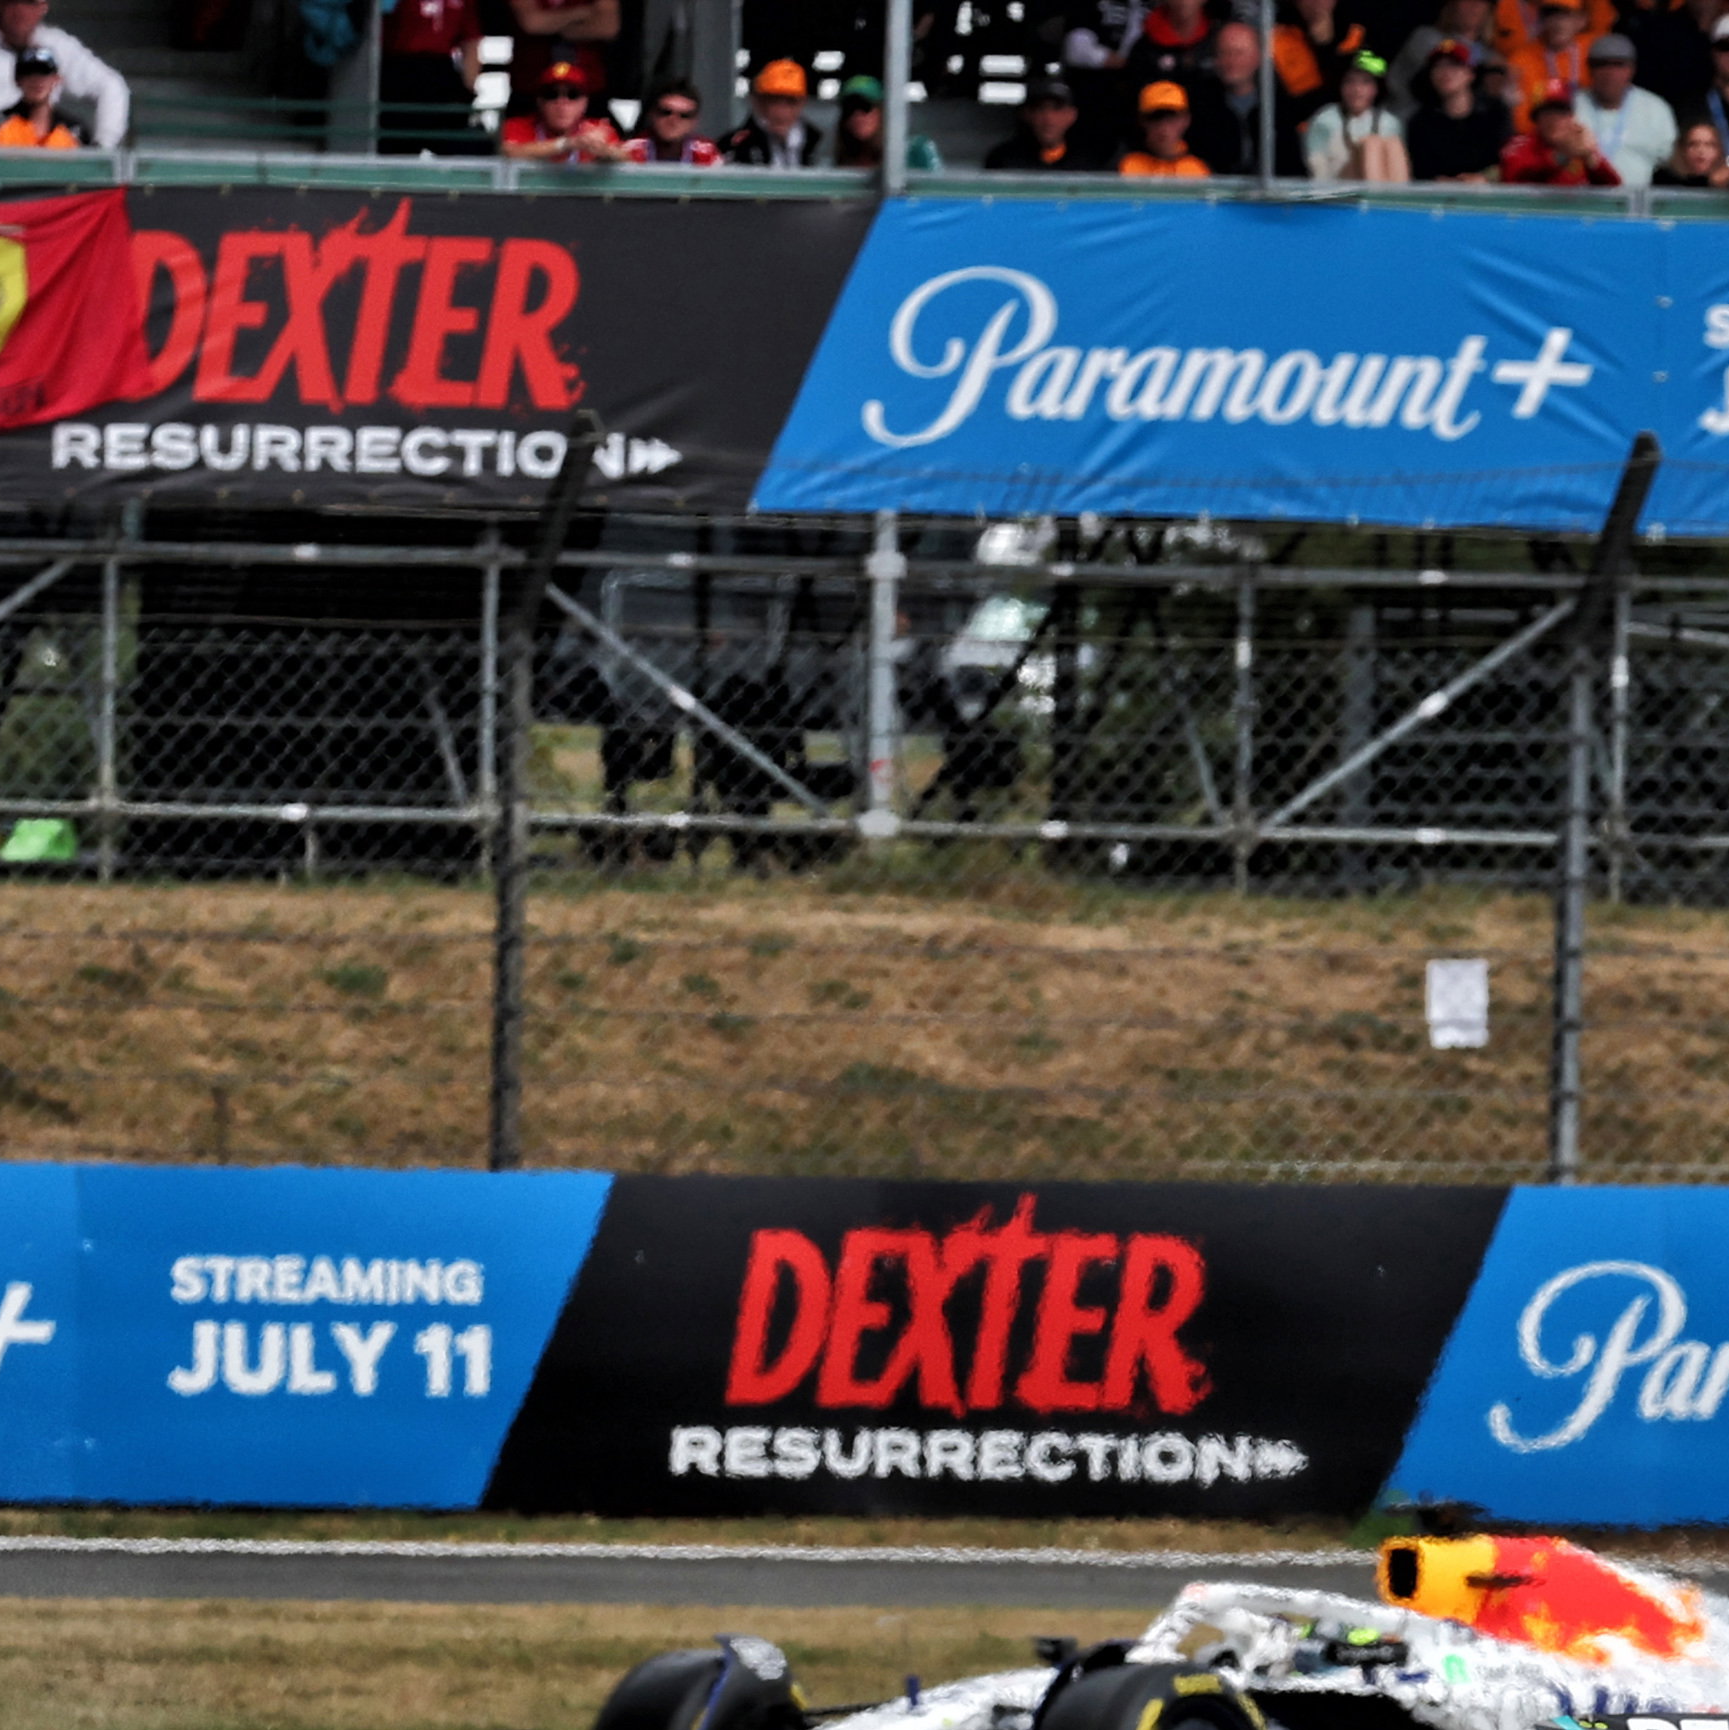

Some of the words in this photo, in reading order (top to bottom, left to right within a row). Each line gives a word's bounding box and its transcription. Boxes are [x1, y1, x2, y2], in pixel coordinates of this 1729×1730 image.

[130, 197, 589, 414] DEXTER
[862, 265, 1591, 447] Paramount+
[169, 1254, 484, 1304] STREAMING
[725, 1192, 1212, 1418] DEXTER
[168, 1320, 396, 1396] JULY
[414, 1324, 491, 1397] 11
[669, 1425, 1253, 1488] RESURRECTION
